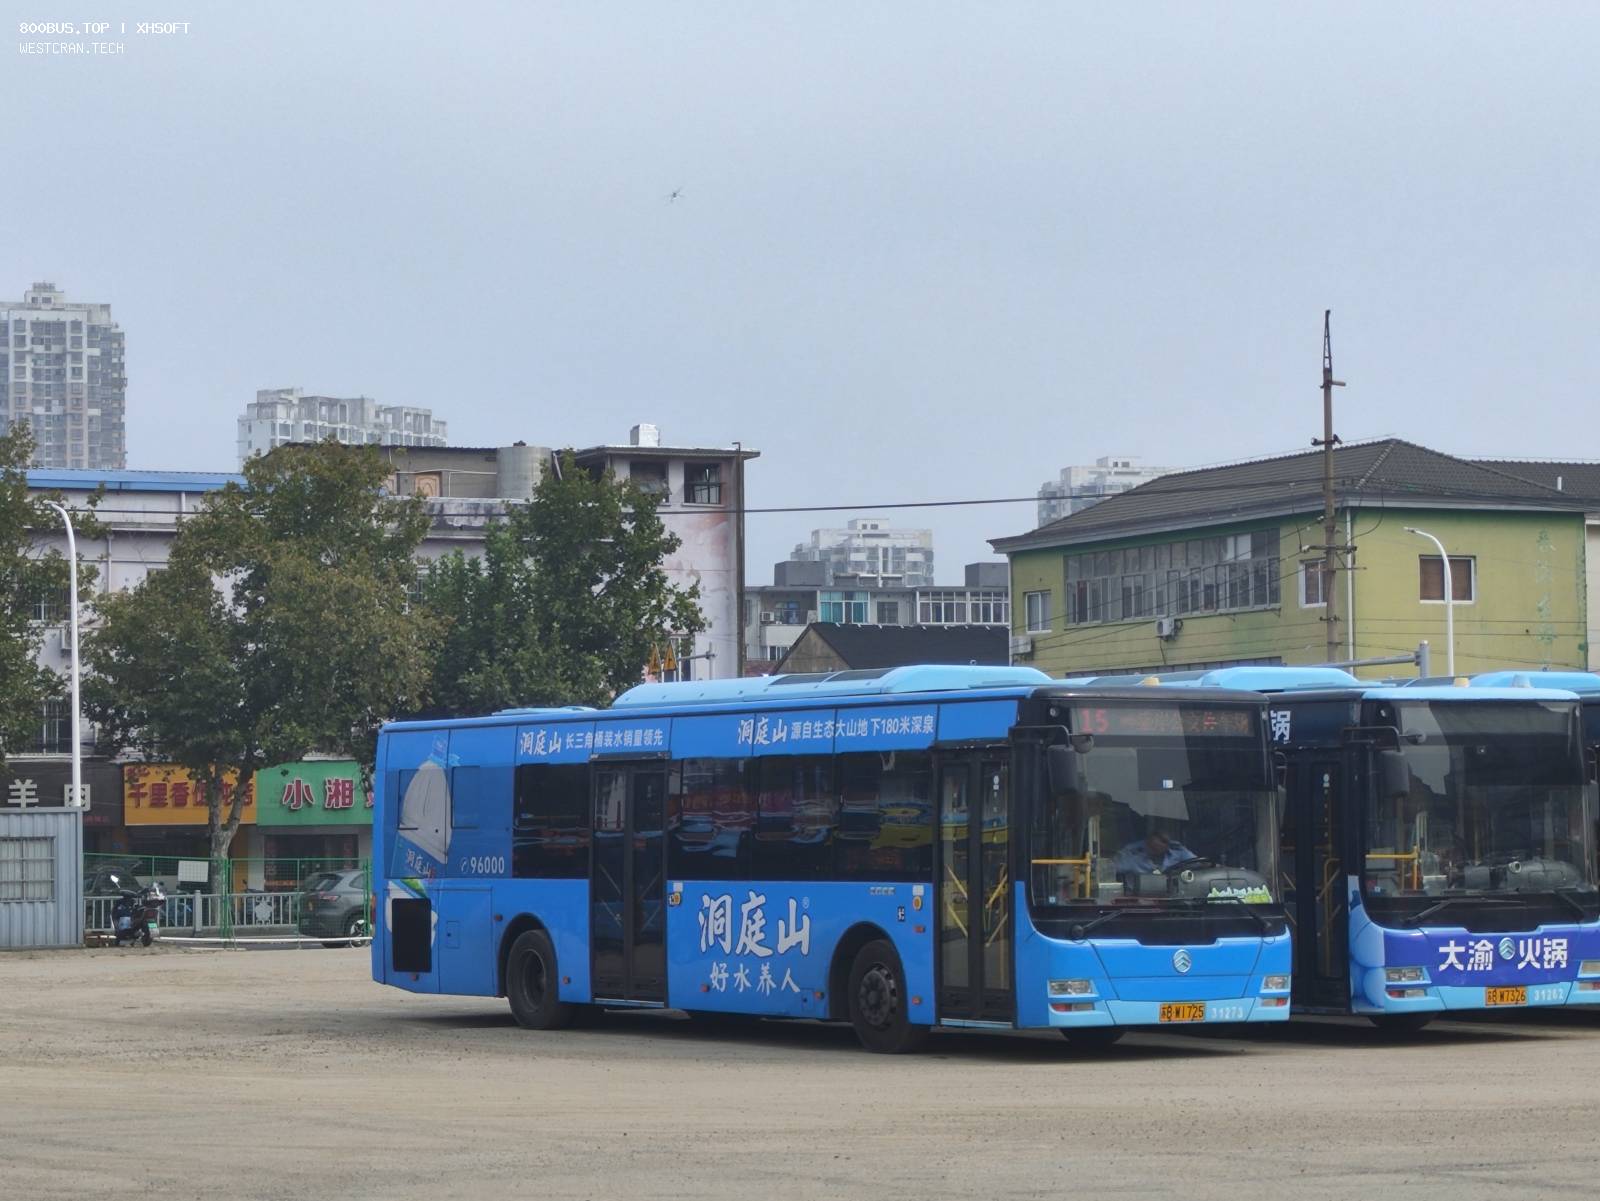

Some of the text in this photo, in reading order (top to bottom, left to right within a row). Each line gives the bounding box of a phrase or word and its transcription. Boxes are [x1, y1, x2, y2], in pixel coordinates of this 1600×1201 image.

[737, 717, 788, 745] 洞庭山
[1080, 709, 1109, 733] 15
[520, 728, 562, 756] 洞庭山
[282, 776, 374, 810] 小湘
[470, 856, 505, 874] 96000
[698, 890, 811, 958] 洞庭山
[709, 961, 801, 996] 好水养人
